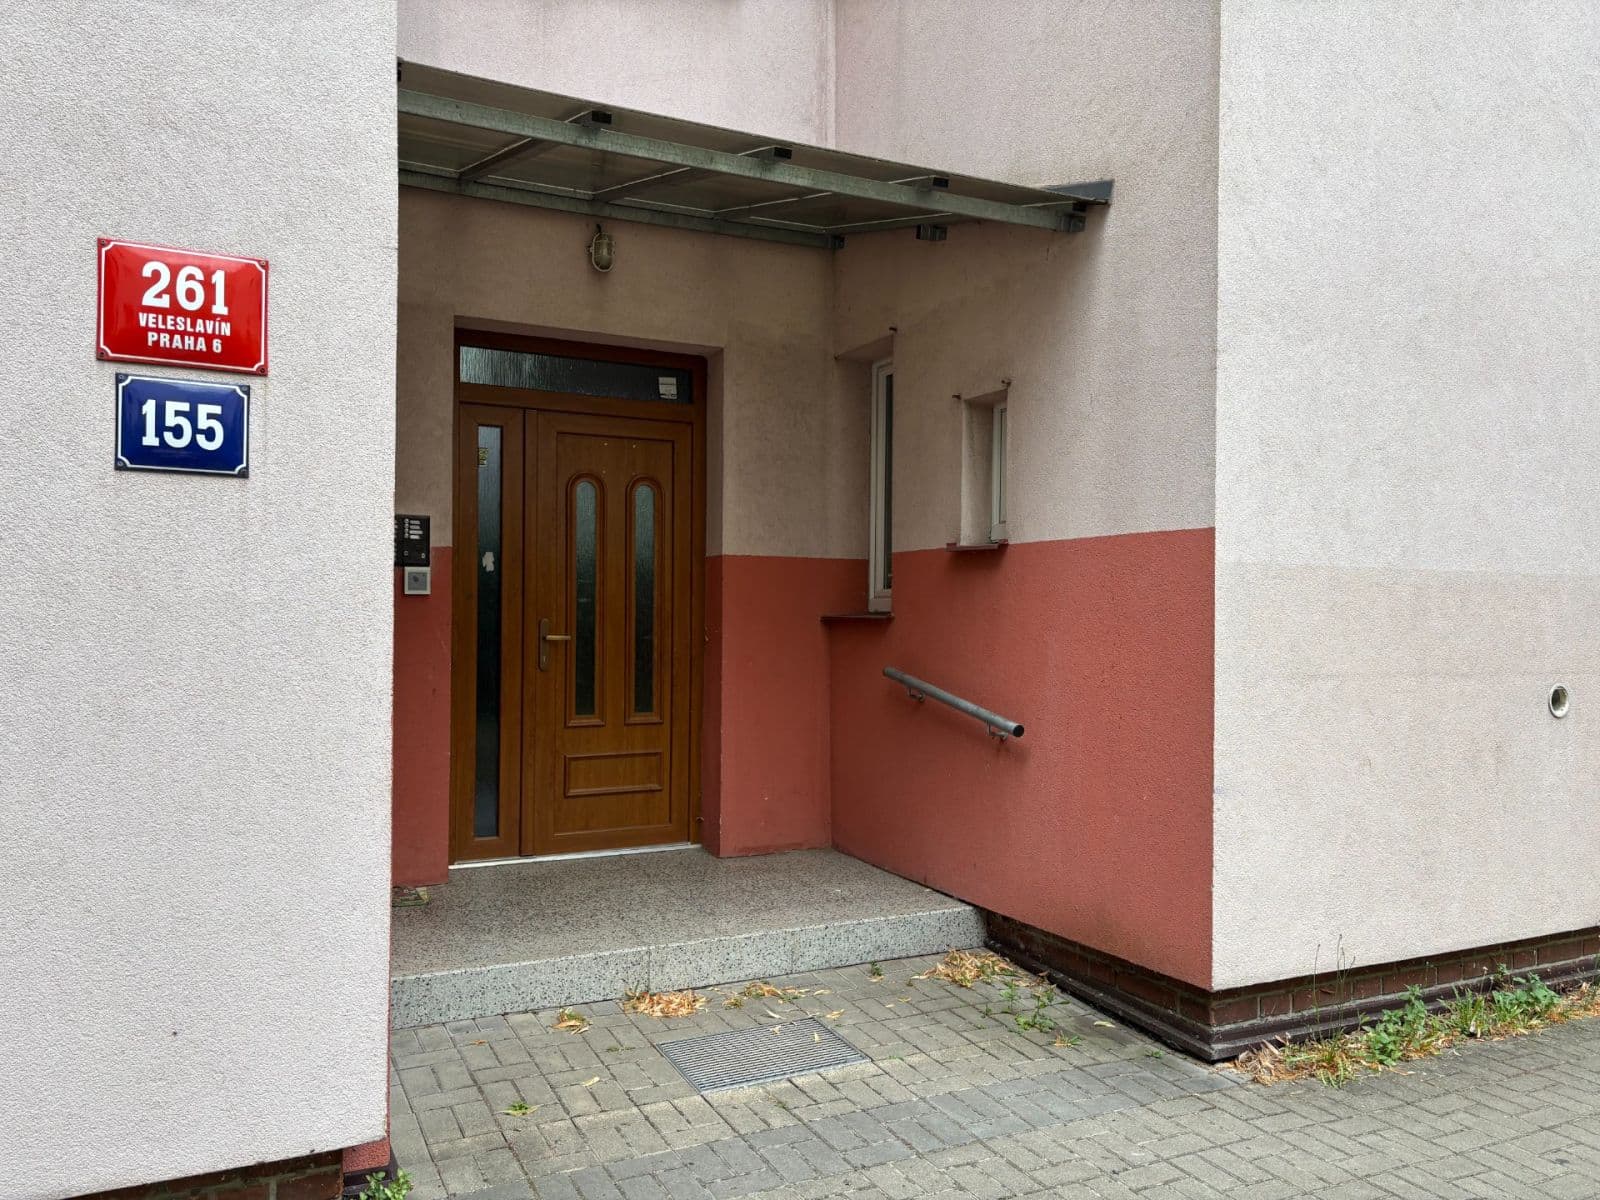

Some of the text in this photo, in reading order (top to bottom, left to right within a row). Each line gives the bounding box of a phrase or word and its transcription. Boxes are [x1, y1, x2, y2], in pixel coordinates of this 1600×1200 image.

[141, 260, 229, 316] 261
[138, 312, 231, 337] VELESLAVÍN
[147, 331, 222, 353] PRAHA 6
[141, 398, 225, 451] 155
